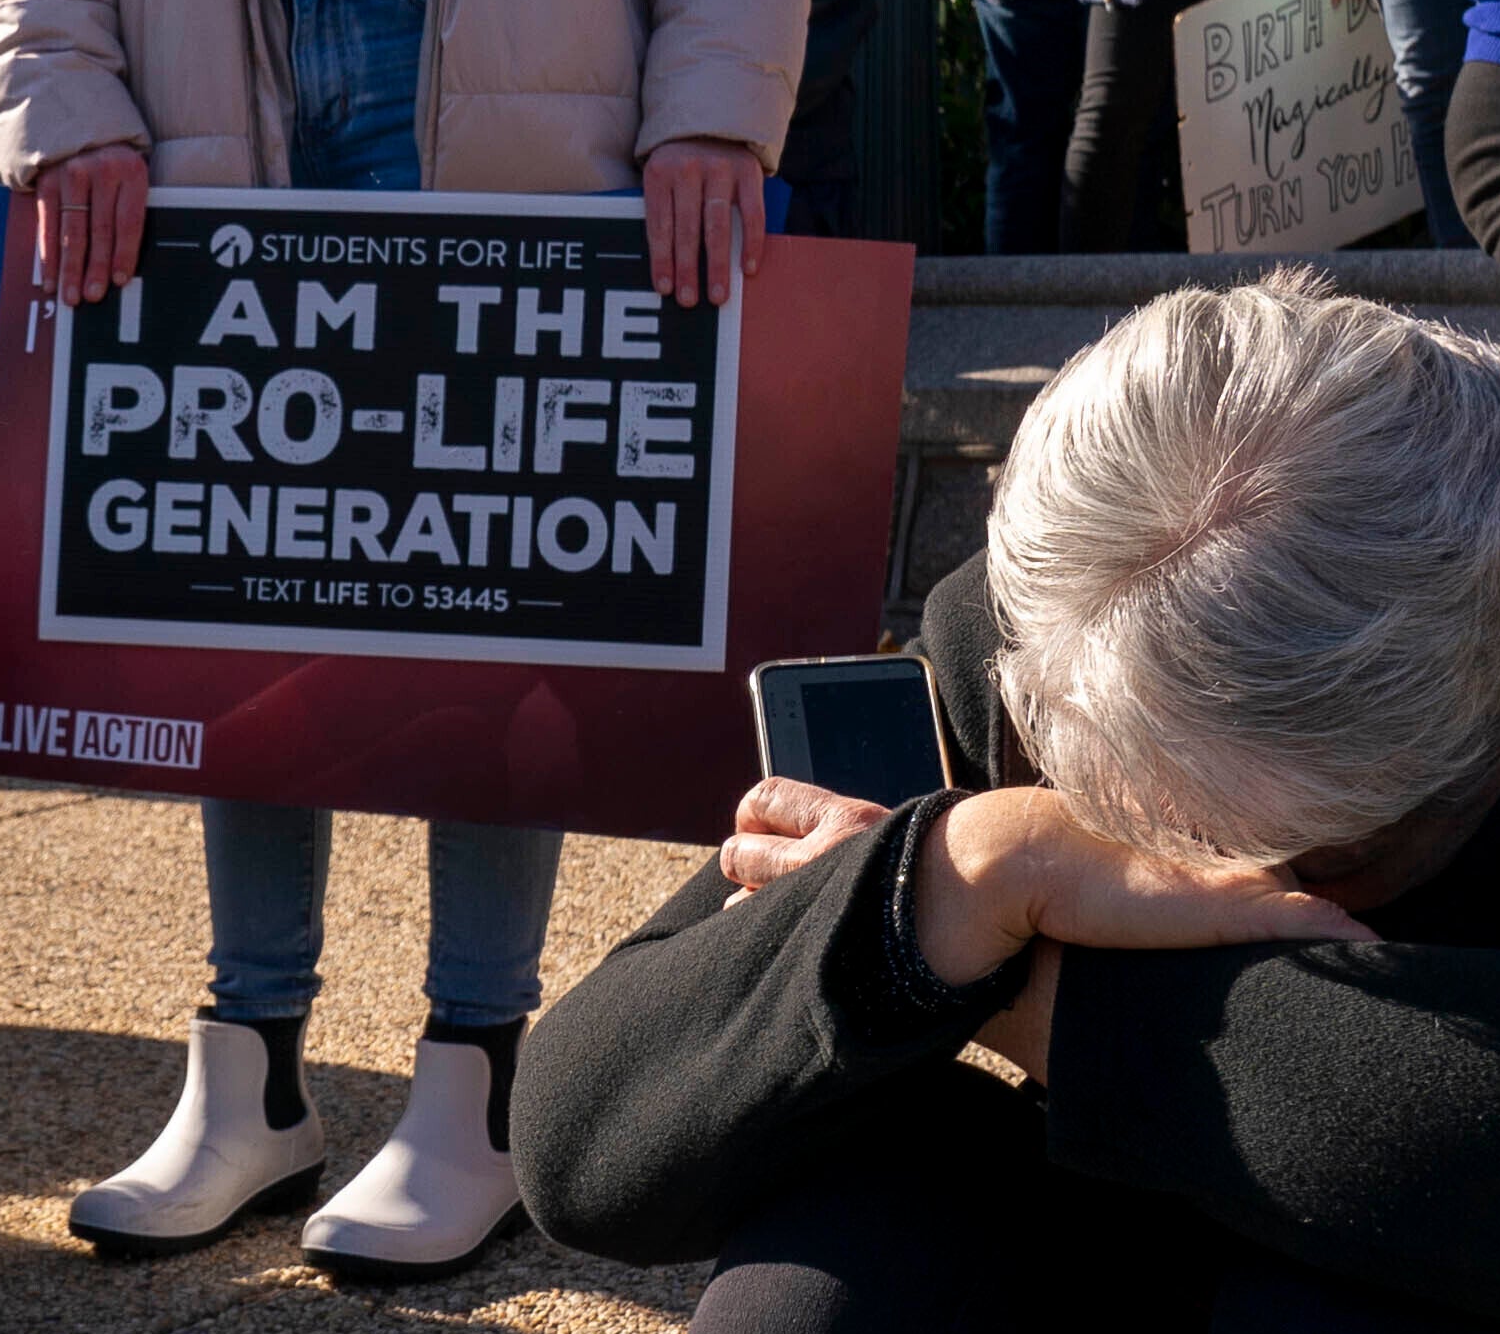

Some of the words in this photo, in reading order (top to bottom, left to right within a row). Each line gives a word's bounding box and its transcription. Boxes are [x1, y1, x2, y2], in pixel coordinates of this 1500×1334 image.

[1243, 54, 1398, 181] Magically
[1202, 177, 1304, 252] TURN
[1317, 147, 1383, 212] YOU
[260, 233, 427, 264] STUDENTS
[438, 237, 507, 268] FOR
[518, 240, 585, 269] LIFE
[24, 298, 57, 353] I'
[117, 276, 143, 343] I
[200, 279, 378, 351] AM
[437, 284, 663, 359] THE
[81, 362, 696, 480] PRO-LIFE
[86, 478, 677, 576] GENERATION
[242, 576, 307, 603] TEXT
[313, 580, 369, 606] LIFE
[377, 582, 414, 607] TO
[423, 585, 510, 613] 53445
[80, 714, 198, 766] ACTION
